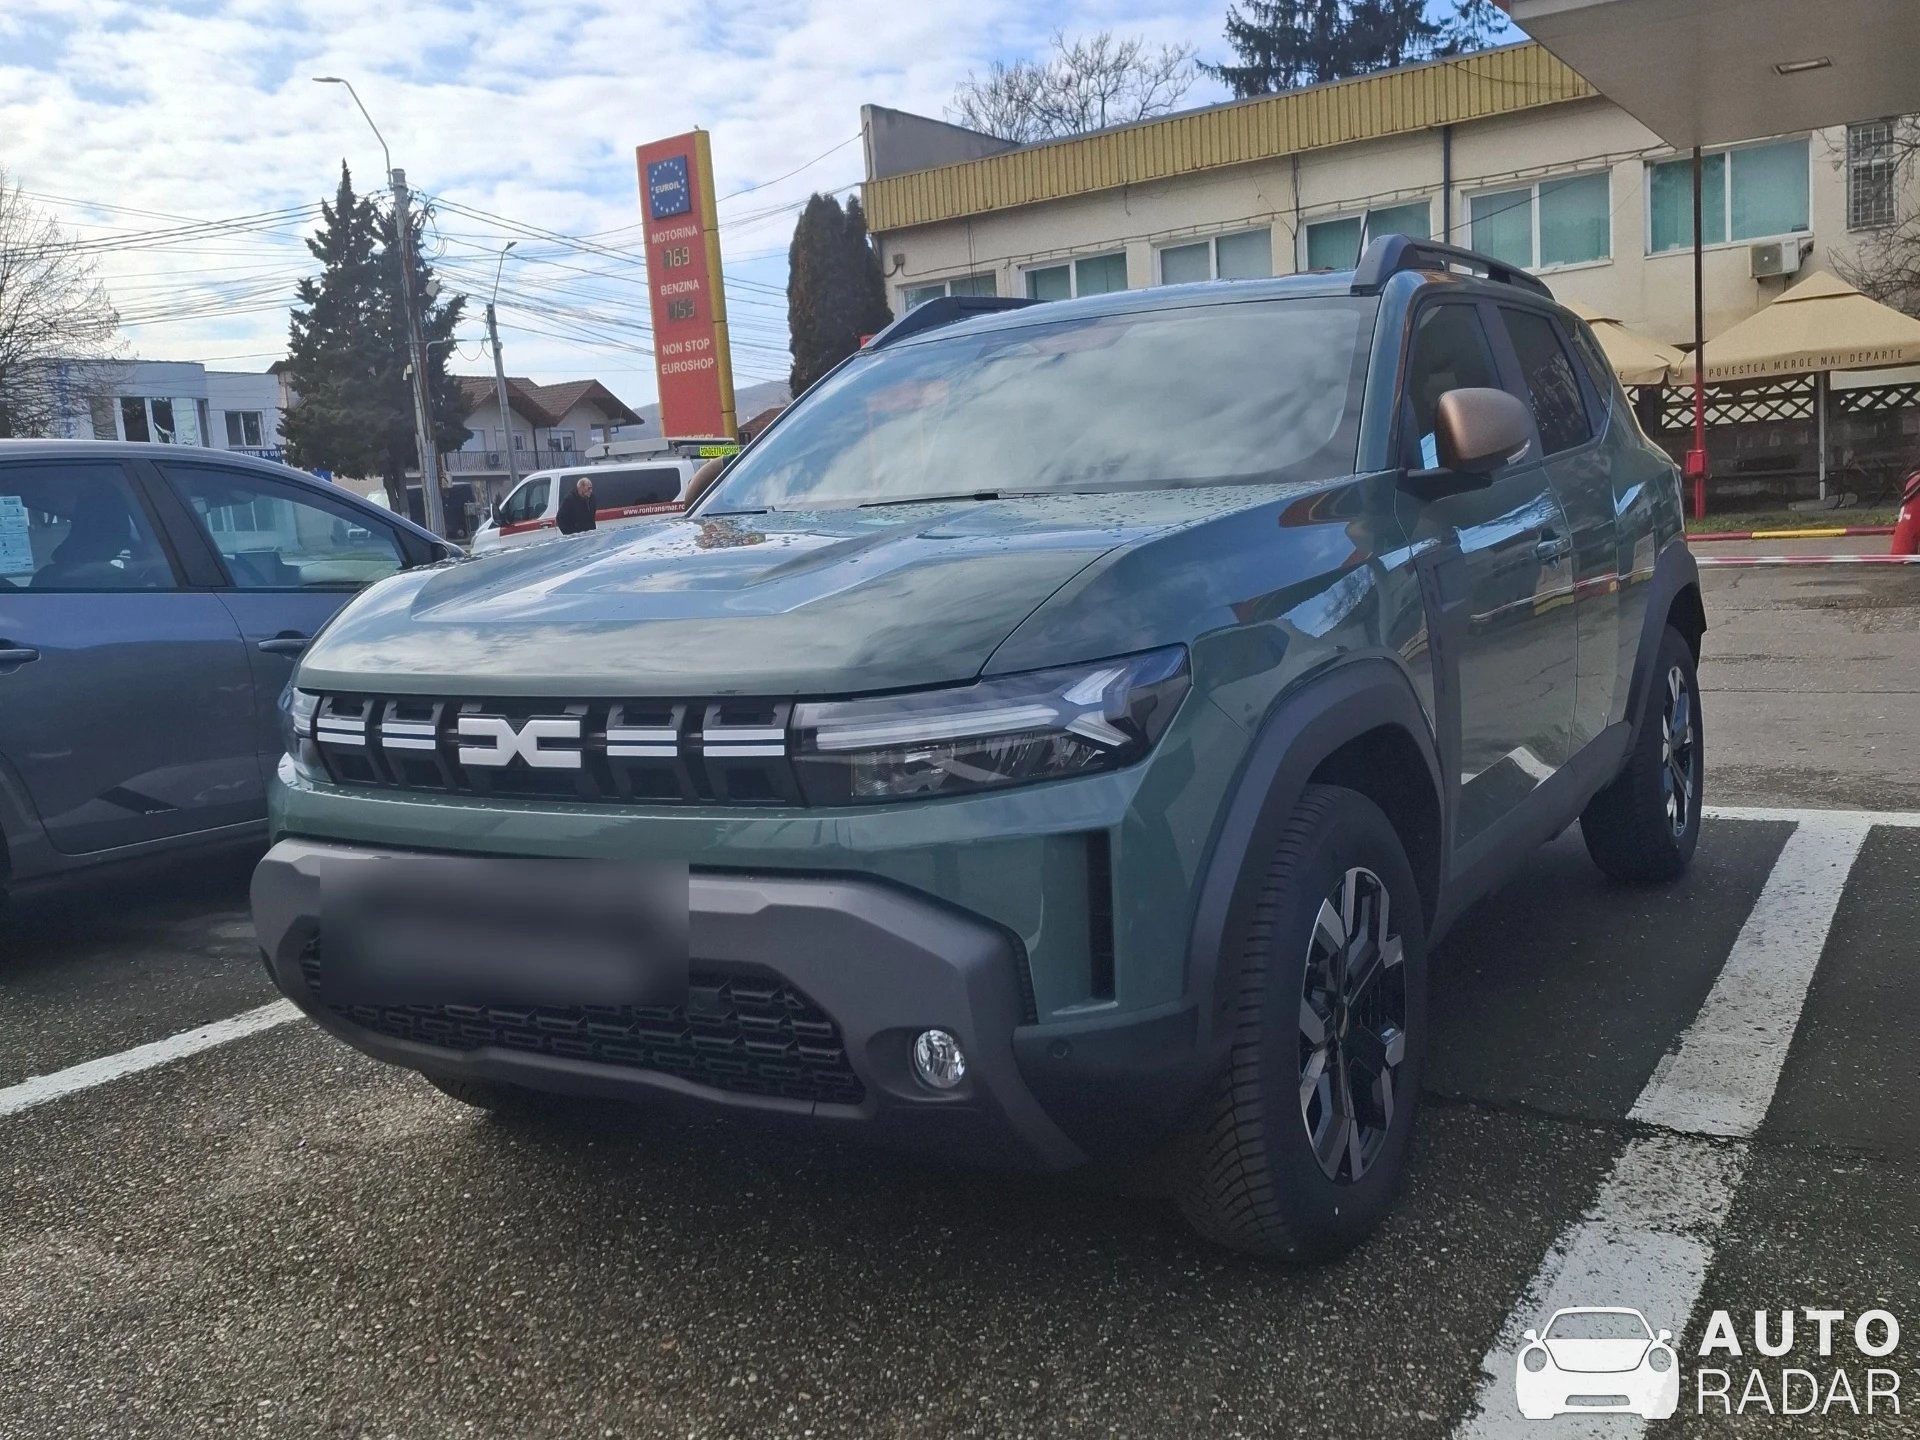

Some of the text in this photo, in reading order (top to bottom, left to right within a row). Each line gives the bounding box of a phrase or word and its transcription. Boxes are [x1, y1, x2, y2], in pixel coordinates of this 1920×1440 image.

[655, 181, 681, 194] EUROIL
[652, 225, 698, 244] MOTORINA
[666, 246, 690, 267] 769
[661, 279, 700, 296] BENZINA
[662, 338, 710, 356] NON STOP
[661, 357, 714, 375] EUROSHOP
[1709, 362, 1766, 378] POVESTEA
[1820, 355, 1842, 365] MAI
[1850, 348, 1903, 363] DEPARTE
